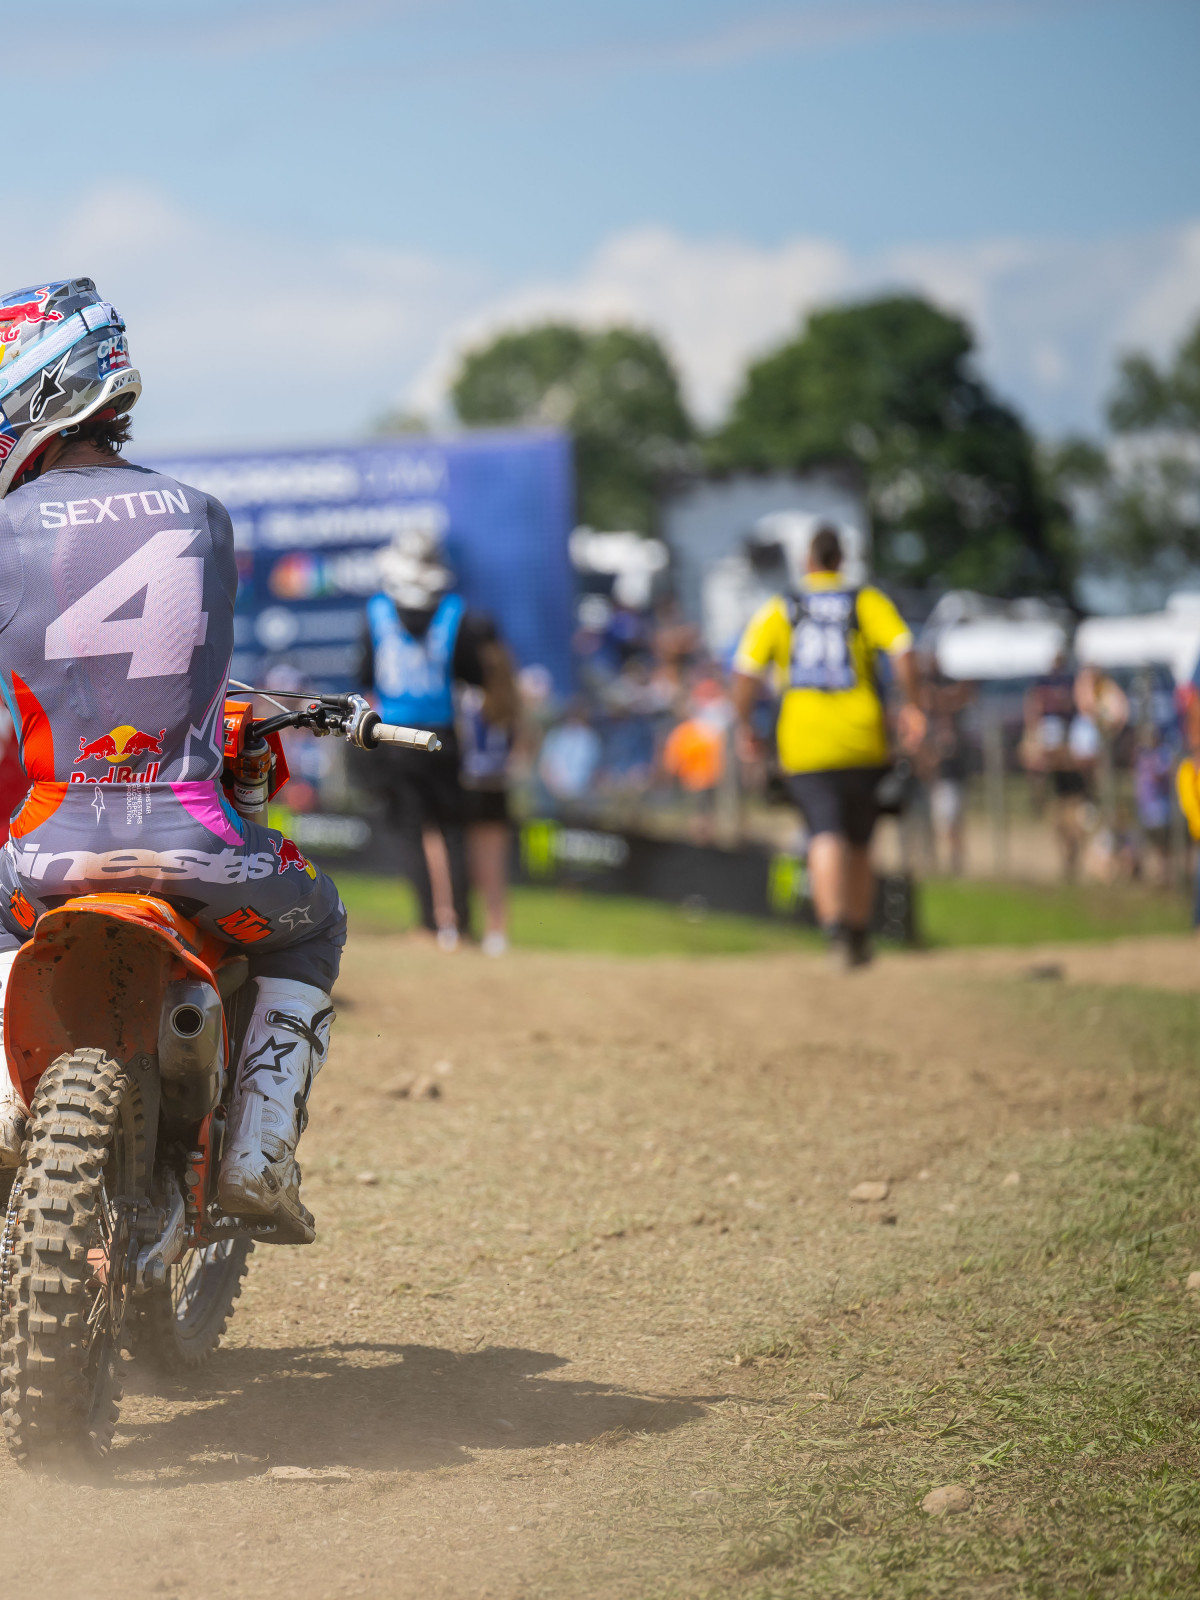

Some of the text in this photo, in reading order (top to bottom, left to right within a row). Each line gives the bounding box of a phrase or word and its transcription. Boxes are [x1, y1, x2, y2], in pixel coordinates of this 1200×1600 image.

[39, 489, 191, 530] SEXTON
[44, 529, 209, 680] 4
[216, 905, 274, 944] KTM
